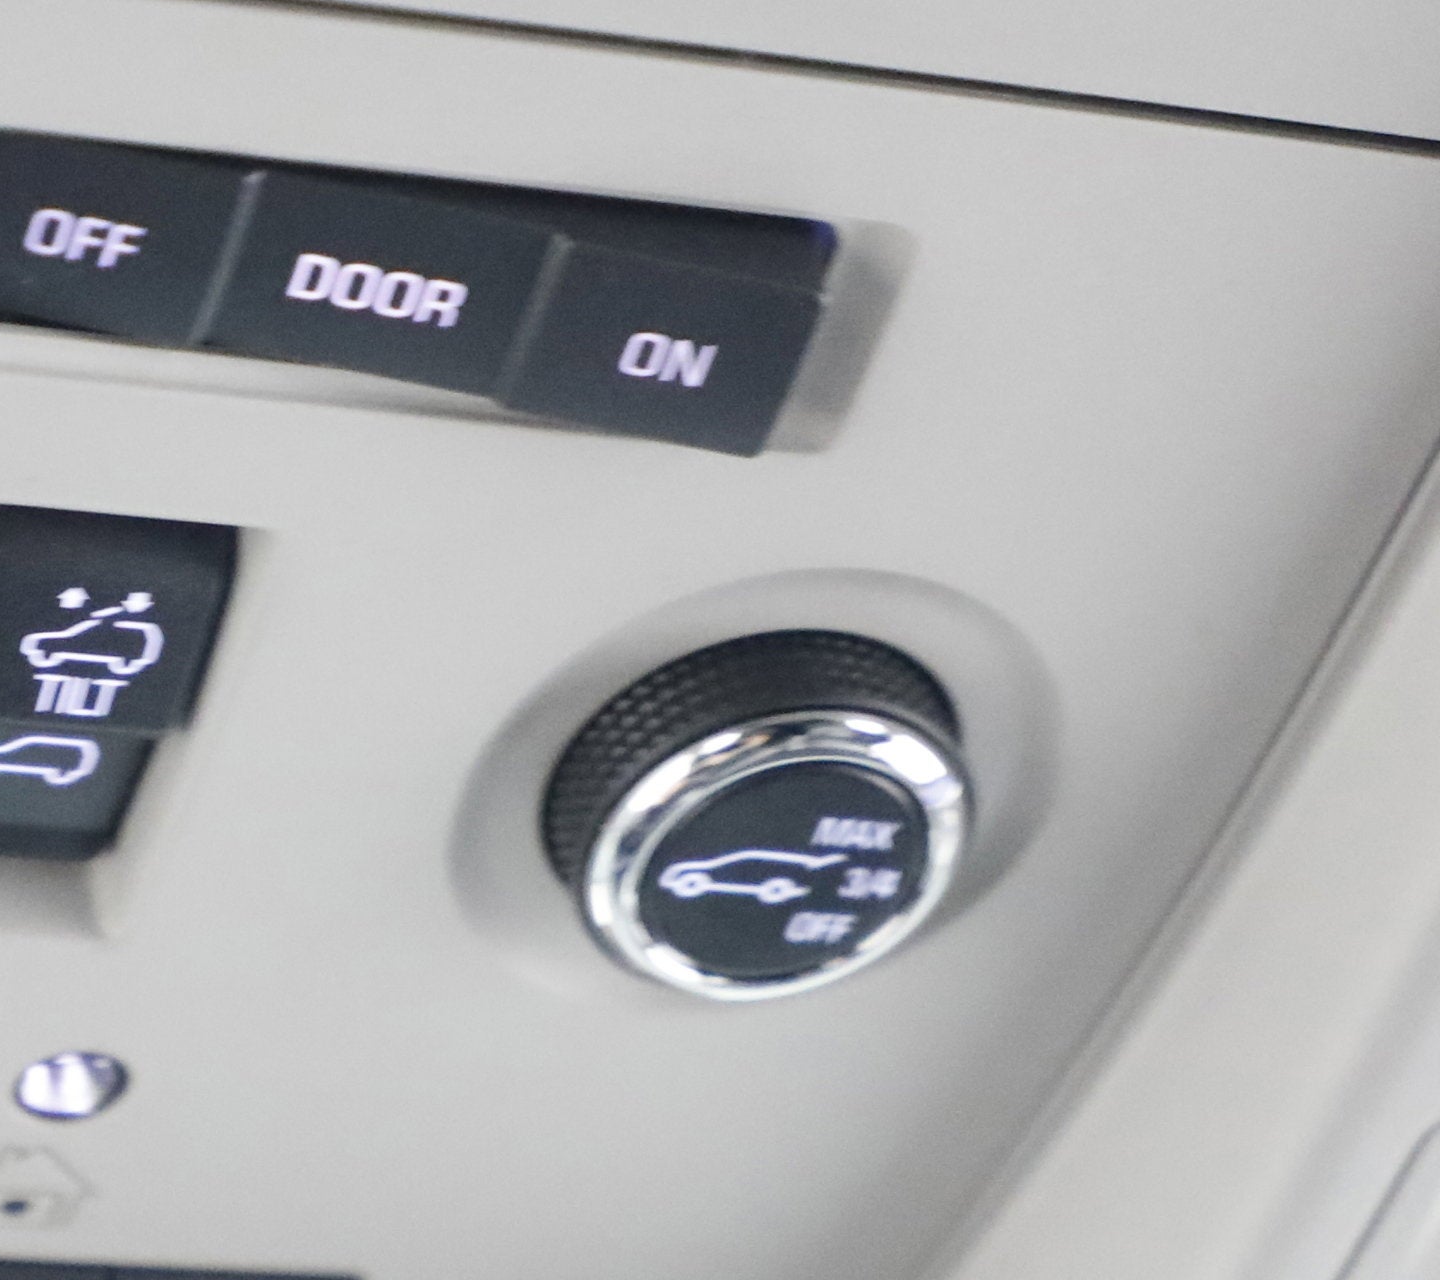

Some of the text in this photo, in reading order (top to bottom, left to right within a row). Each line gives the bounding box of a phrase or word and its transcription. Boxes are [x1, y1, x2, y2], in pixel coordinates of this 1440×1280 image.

[22, 207, 150, 270] OFF
[284, 252, 470, 329] DOOR
[616, 331, 719, 389] ON
[32, 673, 130, 718] TILT
[810, 815, 902, 851] MAX
[782, 910, 858, 945] OFF
